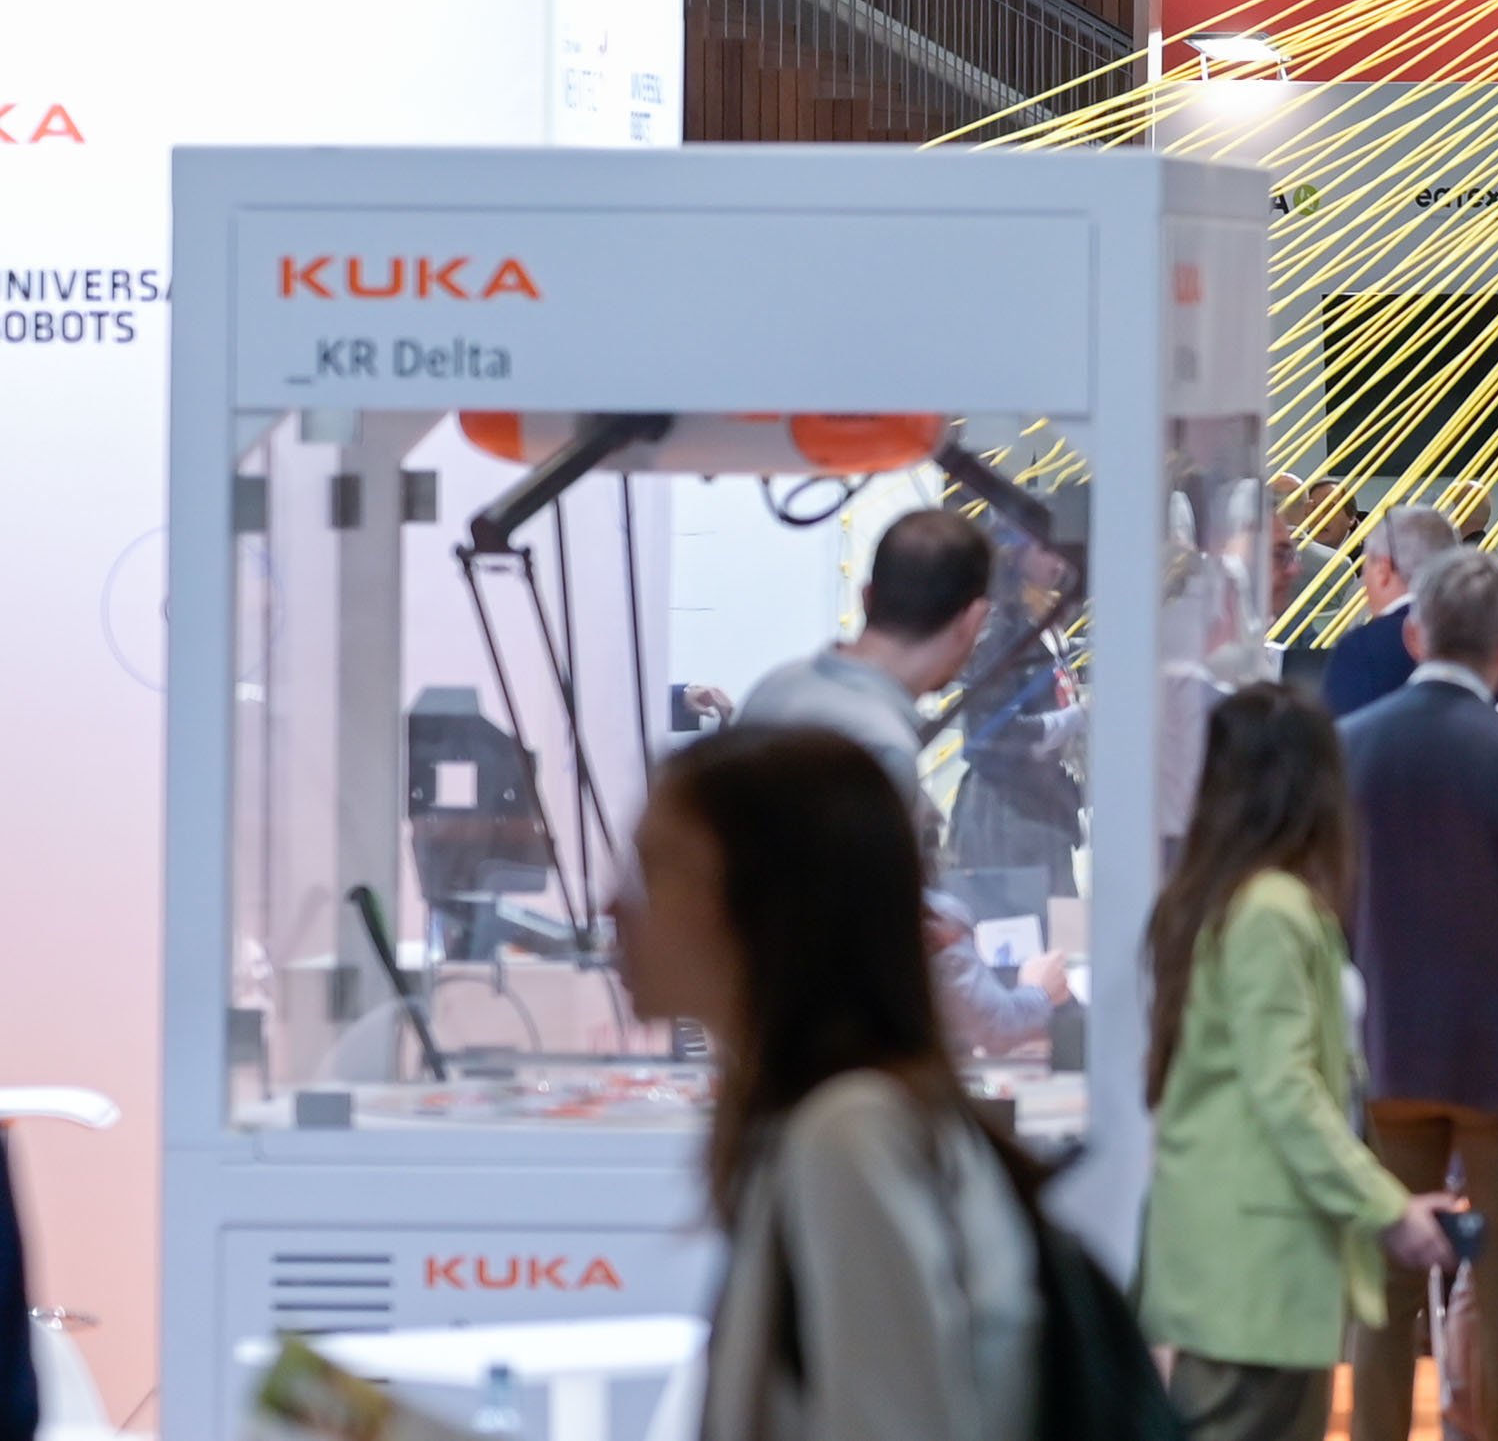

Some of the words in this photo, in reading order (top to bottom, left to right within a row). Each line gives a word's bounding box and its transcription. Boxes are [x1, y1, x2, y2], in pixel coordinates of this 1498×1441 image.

[279, 256, 541, 299] KUKA
[392, 339, 511, 379] Delta
[424, 1254, 622, 1290] KUKA
